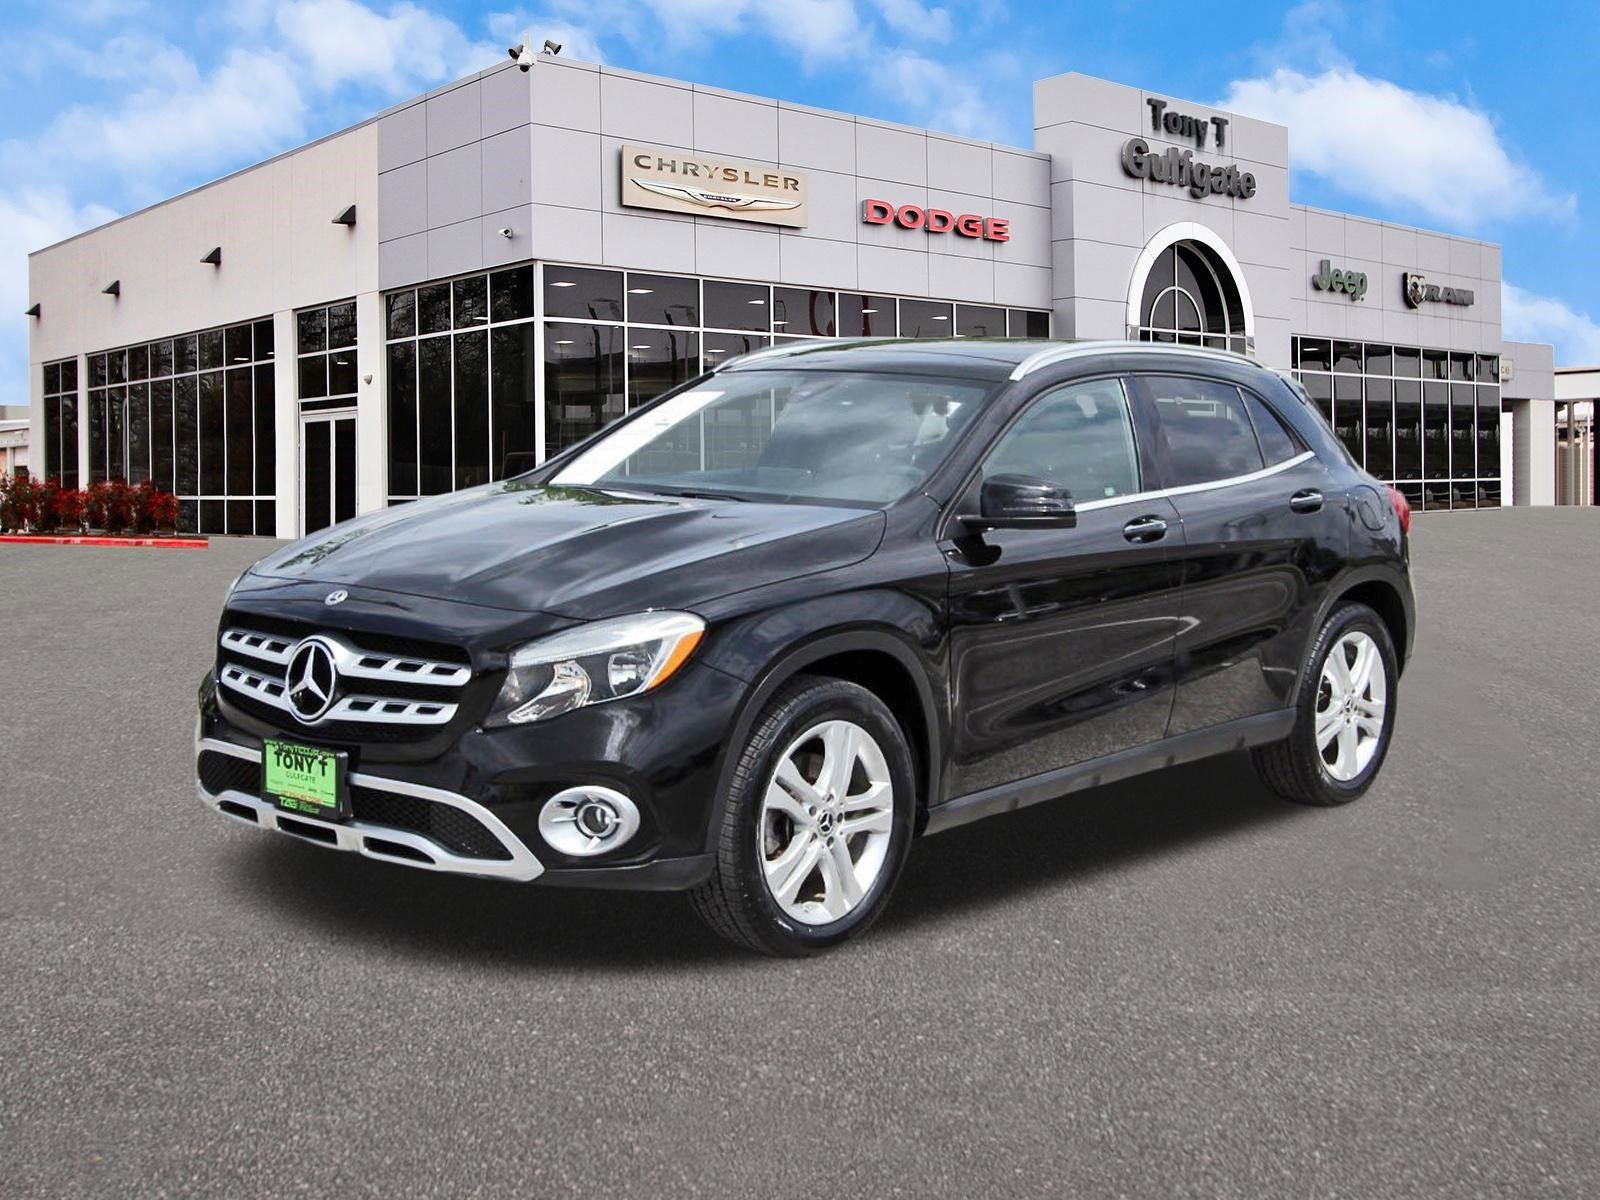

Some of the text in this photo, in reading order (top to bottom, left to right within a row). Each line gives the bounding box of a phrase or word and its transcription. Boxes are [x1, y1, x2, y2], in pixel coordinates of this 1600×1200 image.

[1147, 98, 1229, 148] Tony T
[633, 154, 800, 191] CHRYSLER
[1121, 137, 1257, 199] Gulfgate
[862, 198, 1010, 242] DODGE
[1312, 259, 1368, 302] Jeep
[1425, 284, 1475, 306] RAM
[274, 750, 328, 777] TONY T
